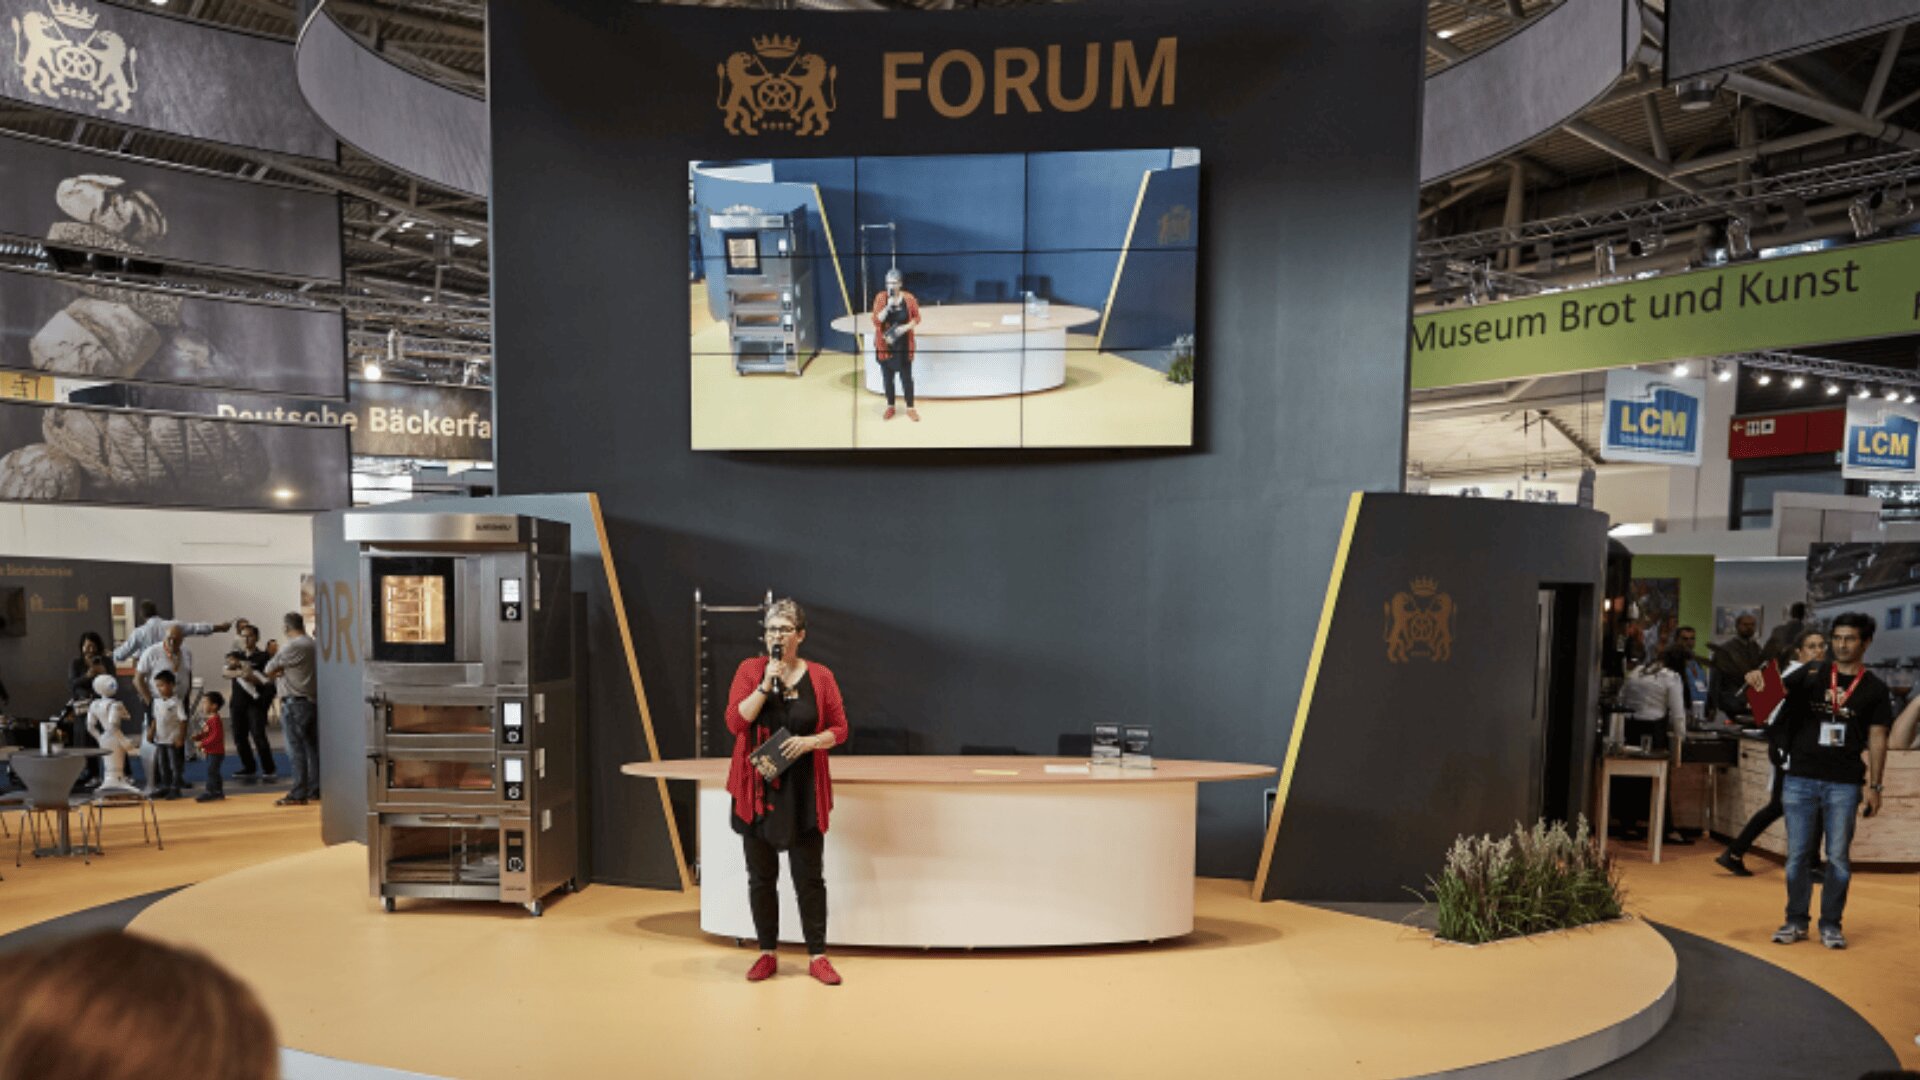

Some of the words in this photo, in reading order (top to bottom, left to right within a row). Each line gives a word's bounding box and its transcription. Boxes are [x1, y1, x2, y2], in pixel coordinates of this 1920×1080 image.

[882, 37, 1178, 119] FORUM
[1412, 311, 1547, 352] Museum
[1560, 293, 1637, 333] Brot
[1650, 275, 1724, 319] und
[1738, 259, 1860, 308] Kunst
[1620, 406, 1687, 437] LCM
[1857, 430, 1909, 457] LCM
